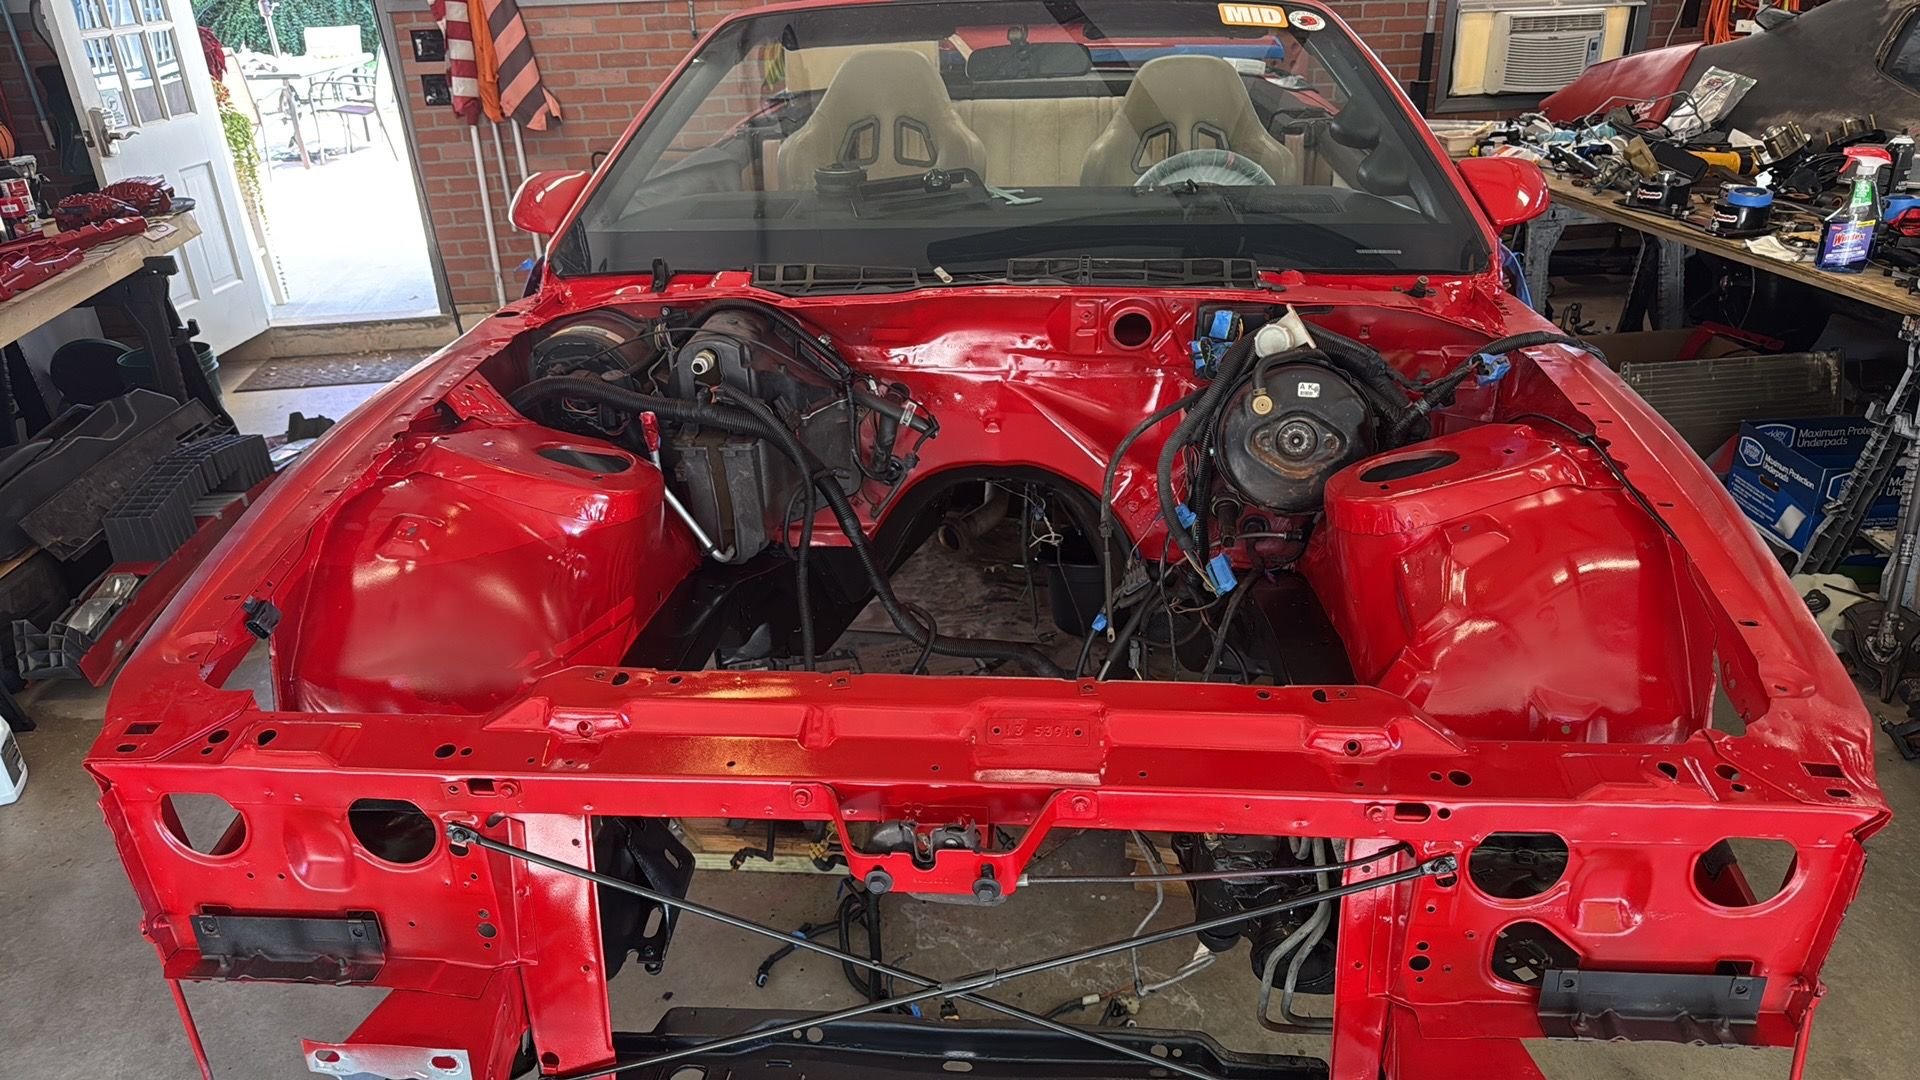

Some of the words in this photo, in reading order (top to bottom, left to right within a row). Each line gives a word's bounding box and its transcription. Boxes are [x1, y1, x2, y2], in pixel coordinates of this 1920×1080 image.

[1223, 5, 1282, 24] MID
[1799, 428, 1846, 438] Maximum
[1847, 426, 1875, 436] Prote
[1797, 437, 1848, 448] Underpads
[1762, 461, 1789, 483] Underpads
[1765, 453, 1789, 473] Maximum
[1789, 468, 1815, 490] Protection
